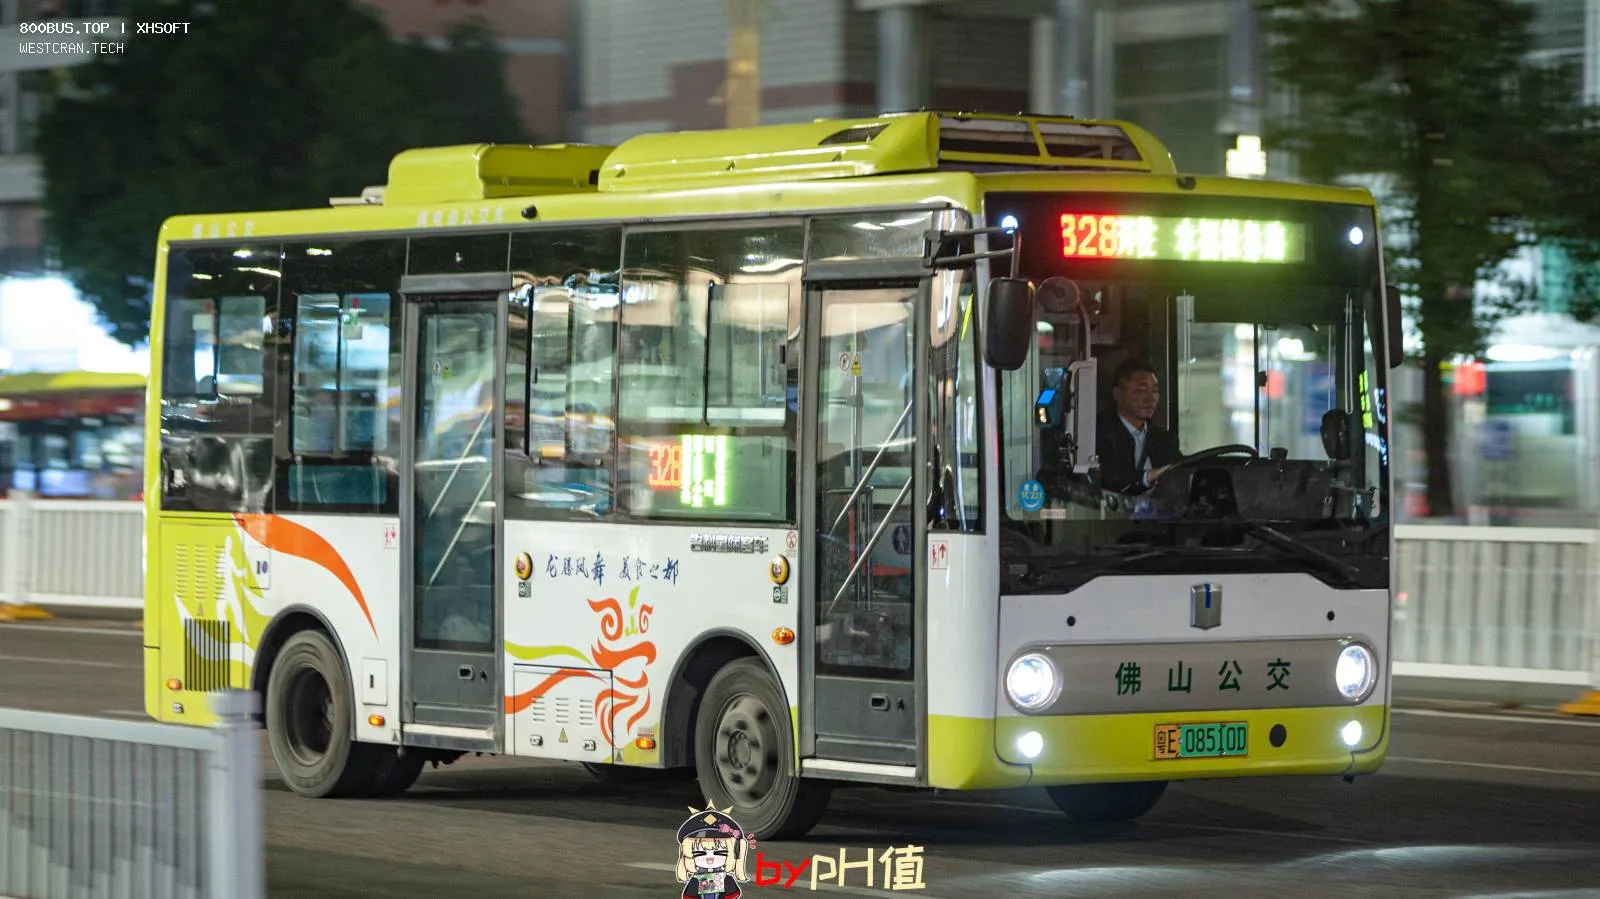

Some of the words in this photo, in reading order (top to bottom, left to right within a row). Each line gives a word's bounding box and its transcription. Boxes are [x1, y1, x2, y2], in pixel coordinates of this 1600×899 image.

[1115, 658, 1291, 695] 佛山公交
[1185, 726, 1247, 753] 08510D
